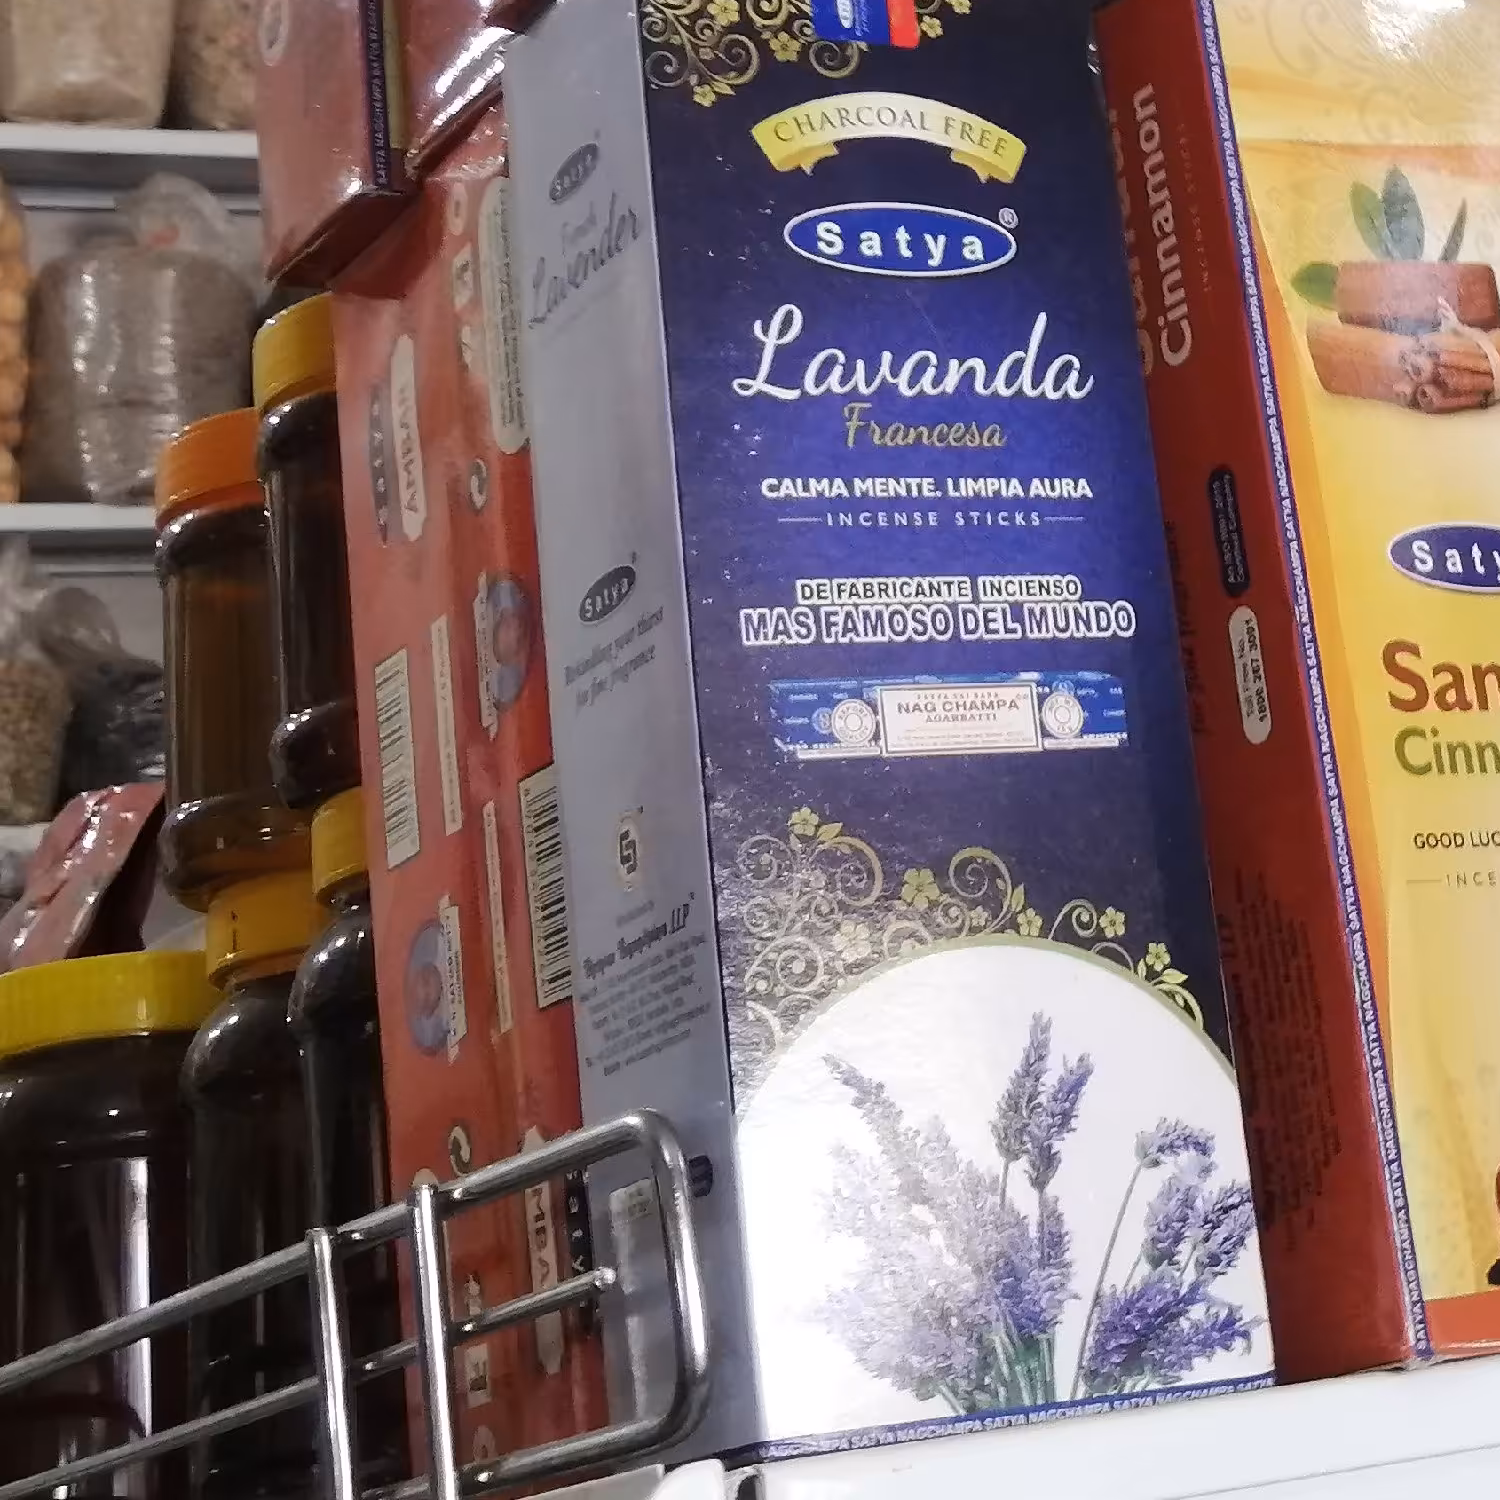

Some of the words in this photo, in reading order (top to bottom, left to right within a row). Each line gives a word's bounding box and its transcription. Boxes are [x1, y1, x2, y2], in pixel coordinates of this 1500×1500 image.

[773, 106, 933, 144] CHARCOAL
[943, 116, 1008, 159] FREE
[817, 221, 986, 268] Satya
[1133, 82, 1194, 368] Cinnamon
[732, 303, 1096, 402] Lavanda
[843, 401, 1007, 450] Francesa
[761, 477, 849, 500] CALMA
[852, 477, 942, 499] MENTE.
[947, 477, 1025, 499] LIMPIA
[1029, 477, 1094, 499] AURA
[826, 512, 940, 528] INCENSE
[954, 511, 1041, 527] STICKS
[797, 579, 831, 603] DE
[835, 577, 972, 601] FABRICANTE
[979, 575, 1081, 599] INCIENSO
[742, 609, 815, 646] MAS
[822, 606, 952, 642] FAMOSO
[961, 605, 1020, 639] DEL
[1028, 602, 1136, 638] MUNDO
[897, 700, 938, 715] NAG
[942, 698, 1019, 714] CHAMPA
[1414, 831, 1465, 851] GOOD
